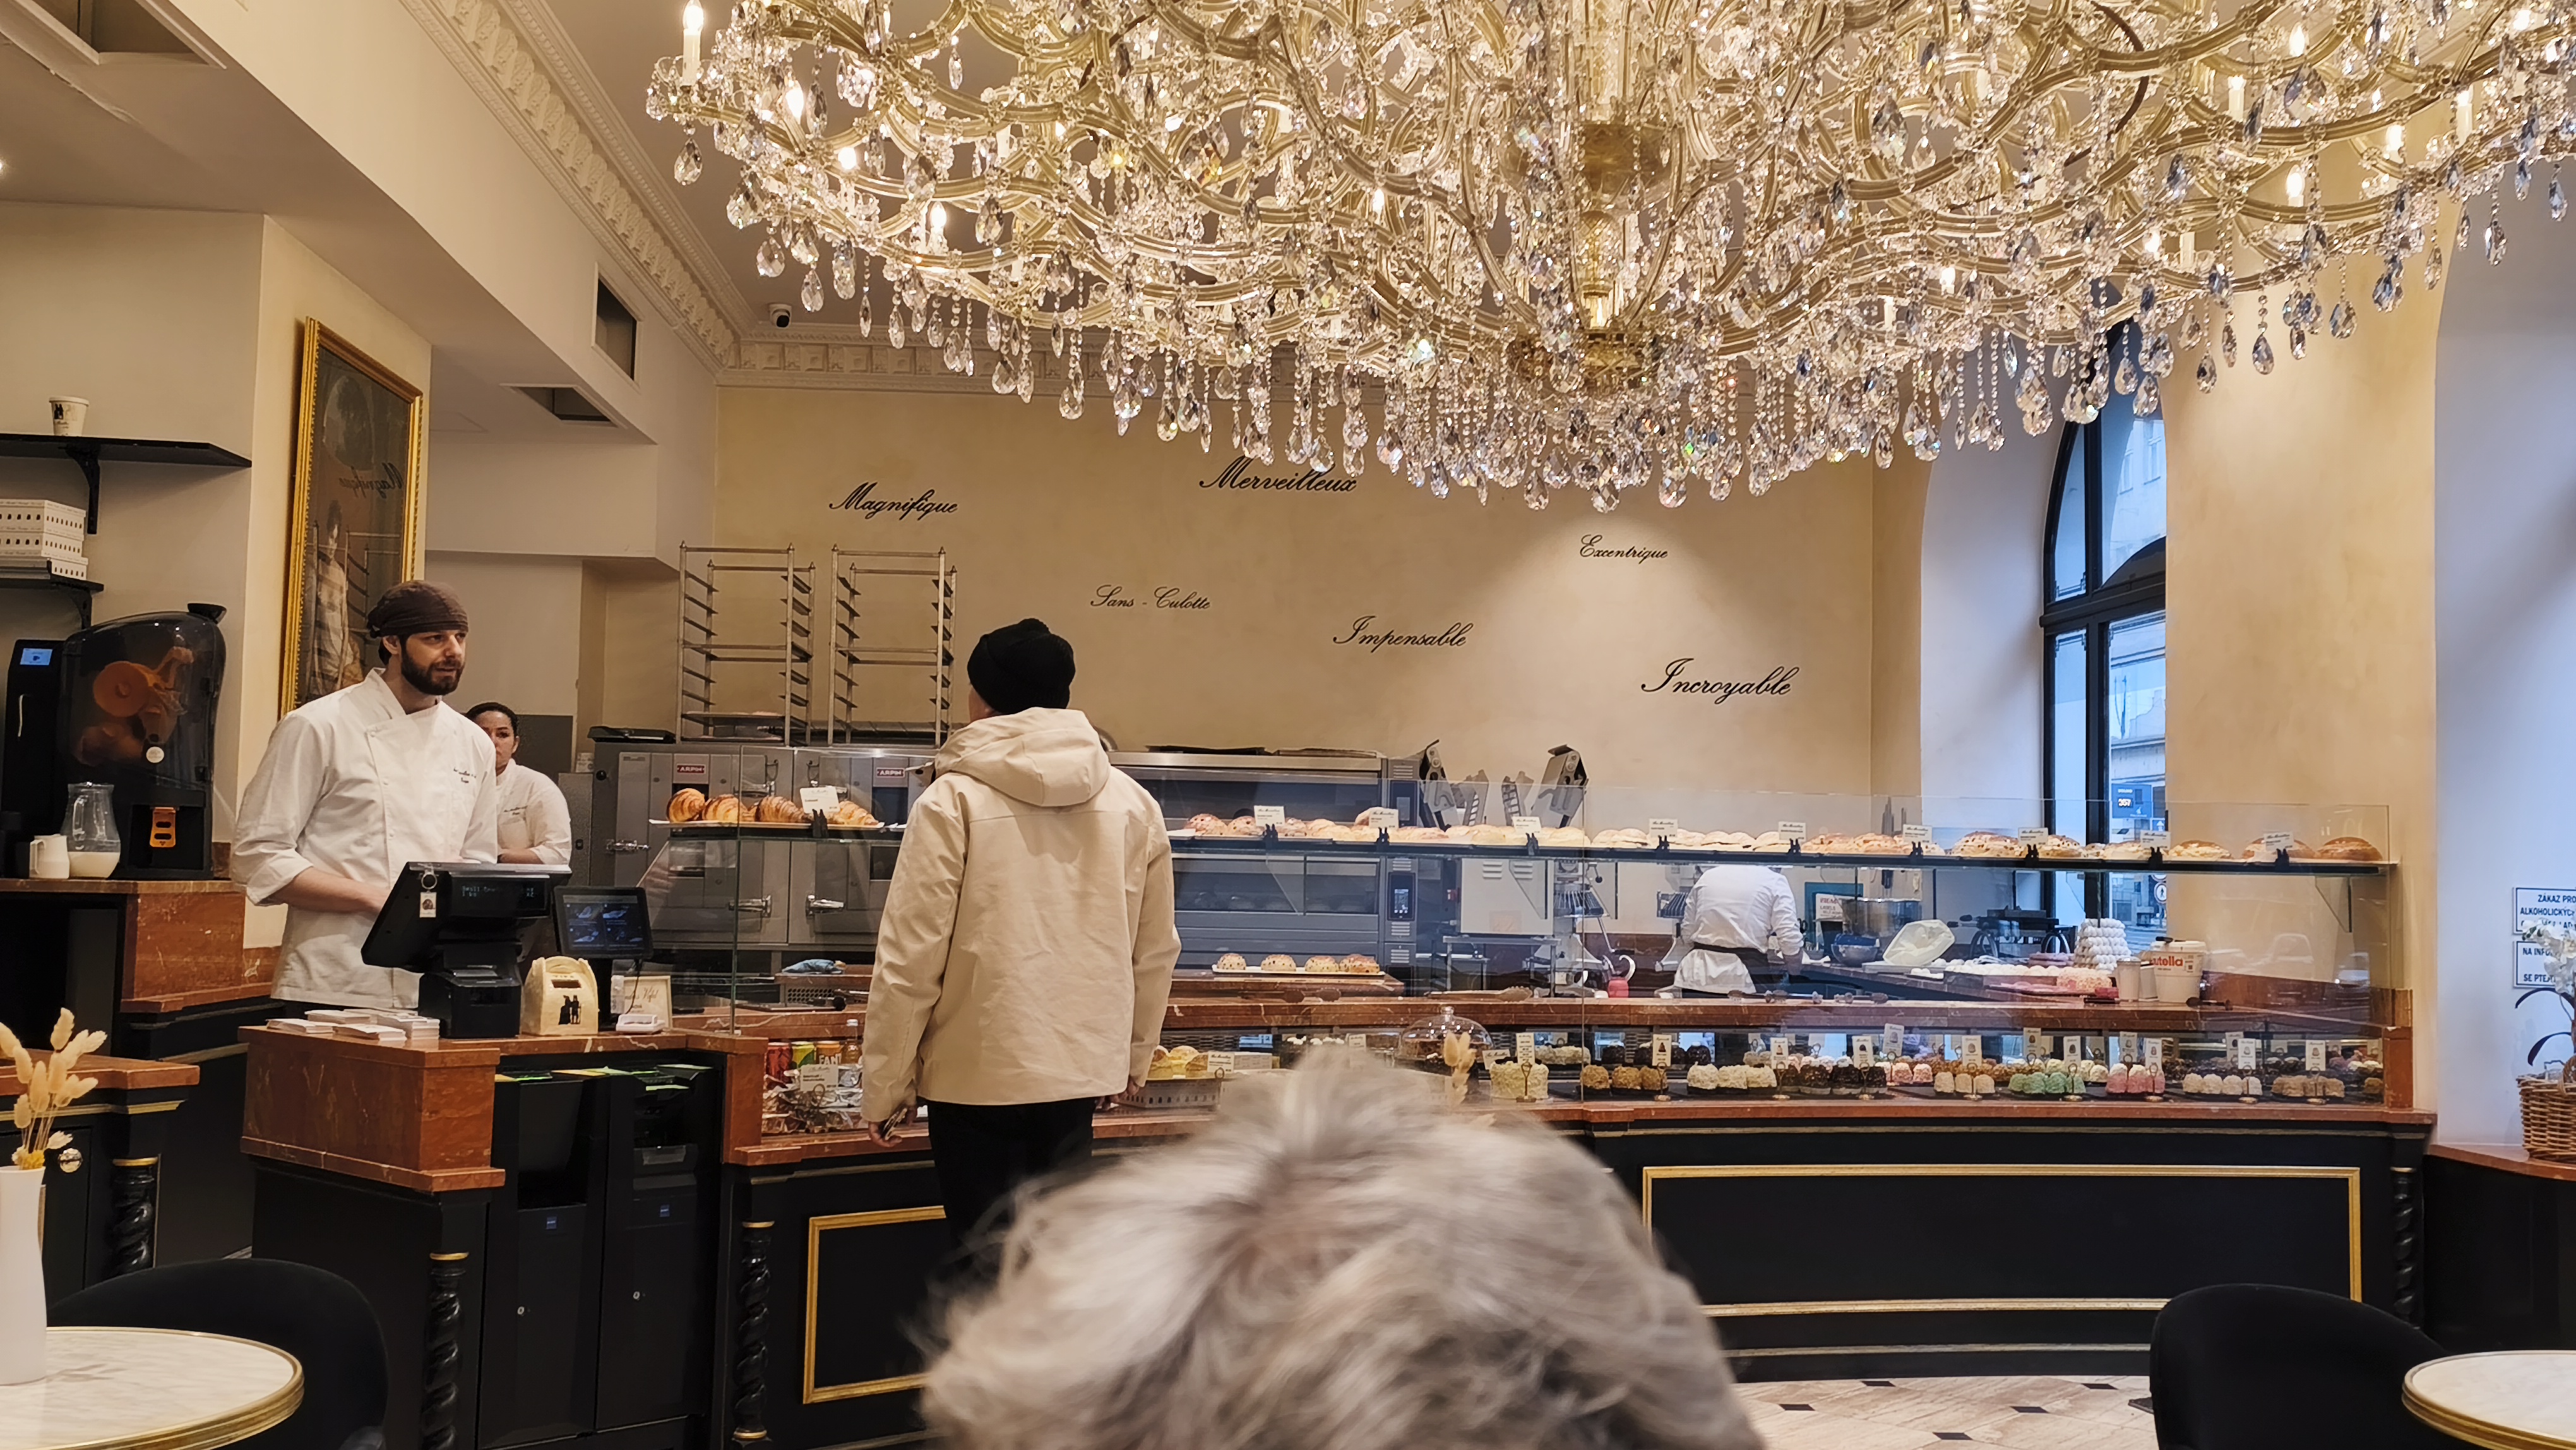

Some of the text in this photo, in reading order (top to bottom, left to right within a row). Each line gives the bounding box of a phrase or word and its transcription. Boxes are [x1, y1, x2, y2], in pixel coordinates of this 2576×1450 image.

[1200, 455, 1357, 492] Merveilleux
[829, 482, 958, 520] Magnifique
[1580, 534, 1668, 564] Excentrique
[1090, 584, 1134, 607] Sans
[1154, 586, 1210, 609] Culotte
[1333, 616, 1474, 653] Impensable
[1642, 658, 1799, 705] Incroyable
[2538, 892, 2560, 903] ZÁKAZ
[2522, 947, 2532, 956] NA
[2524, 973, 2532, 982] SE
